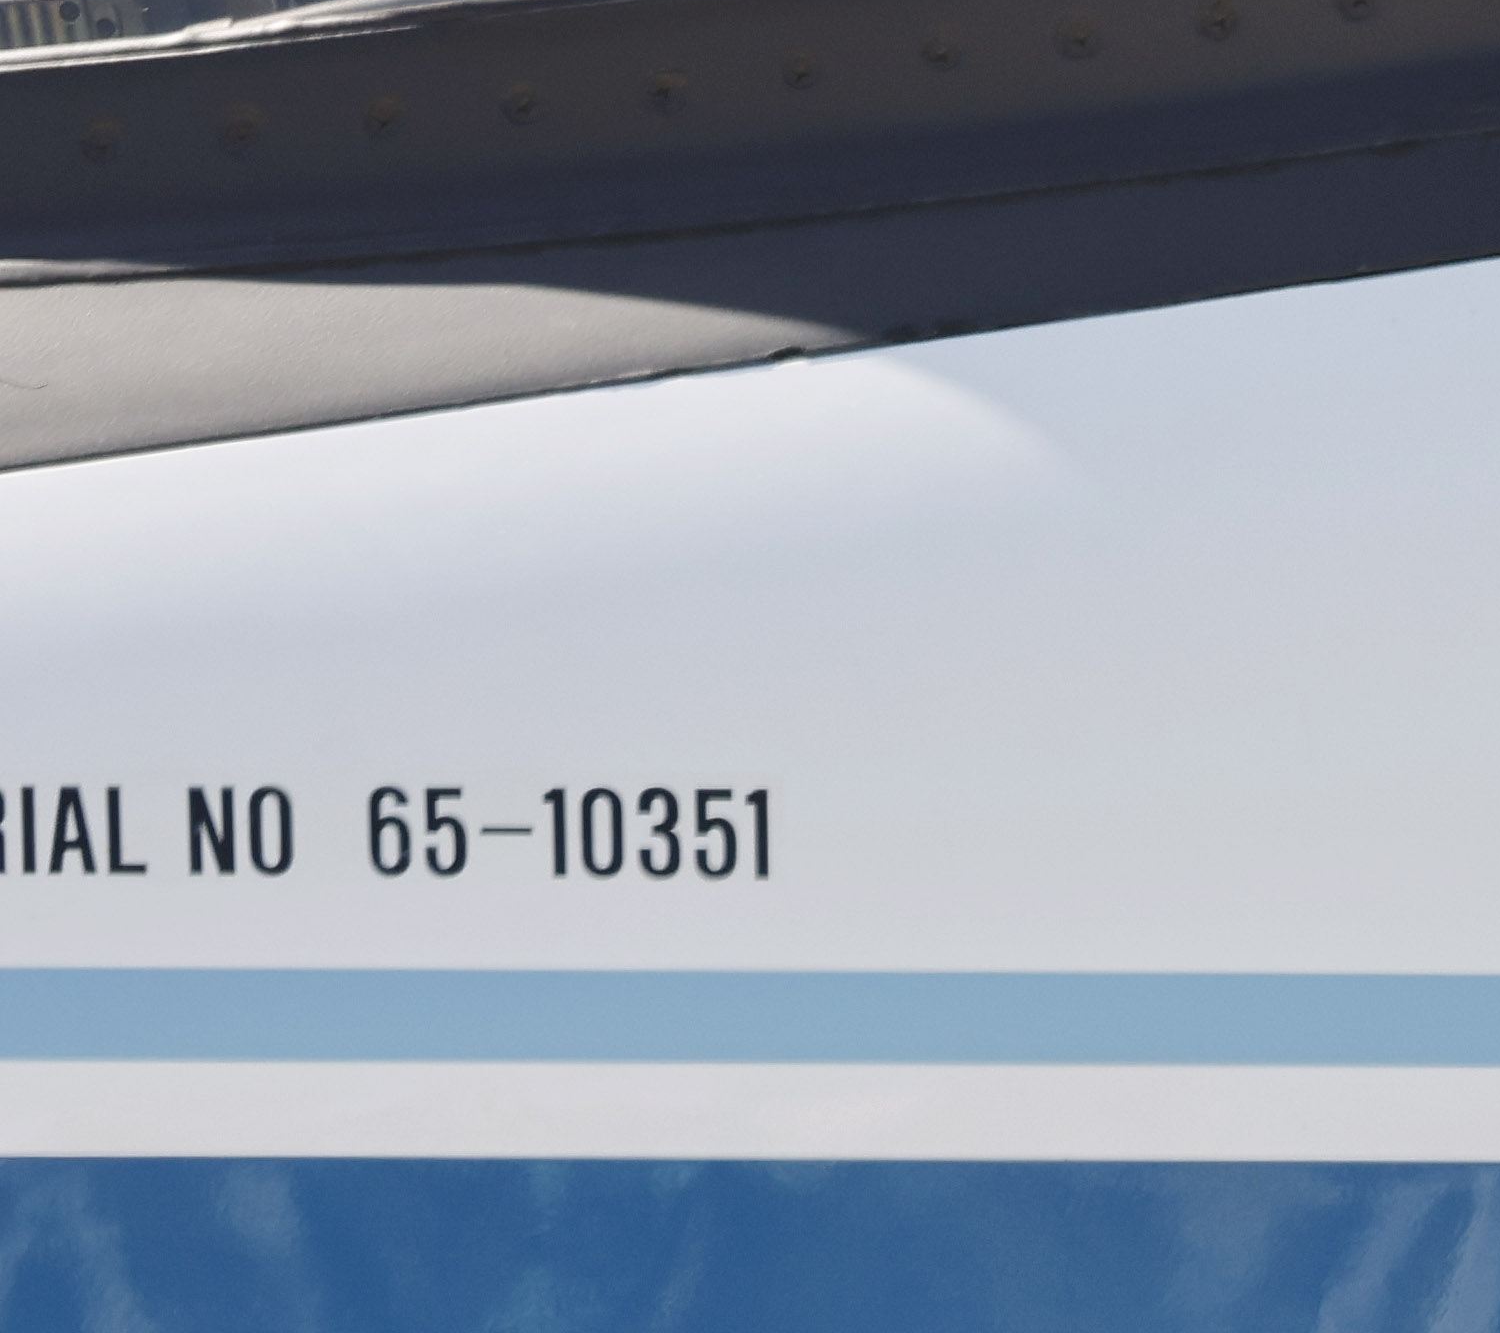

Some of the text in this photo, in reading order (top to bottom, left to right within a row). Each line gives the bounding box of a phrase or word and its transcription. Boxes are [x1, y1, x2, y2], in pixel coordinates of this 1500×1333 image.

[0, 785, 770, 878] IAL NO 65-10351
